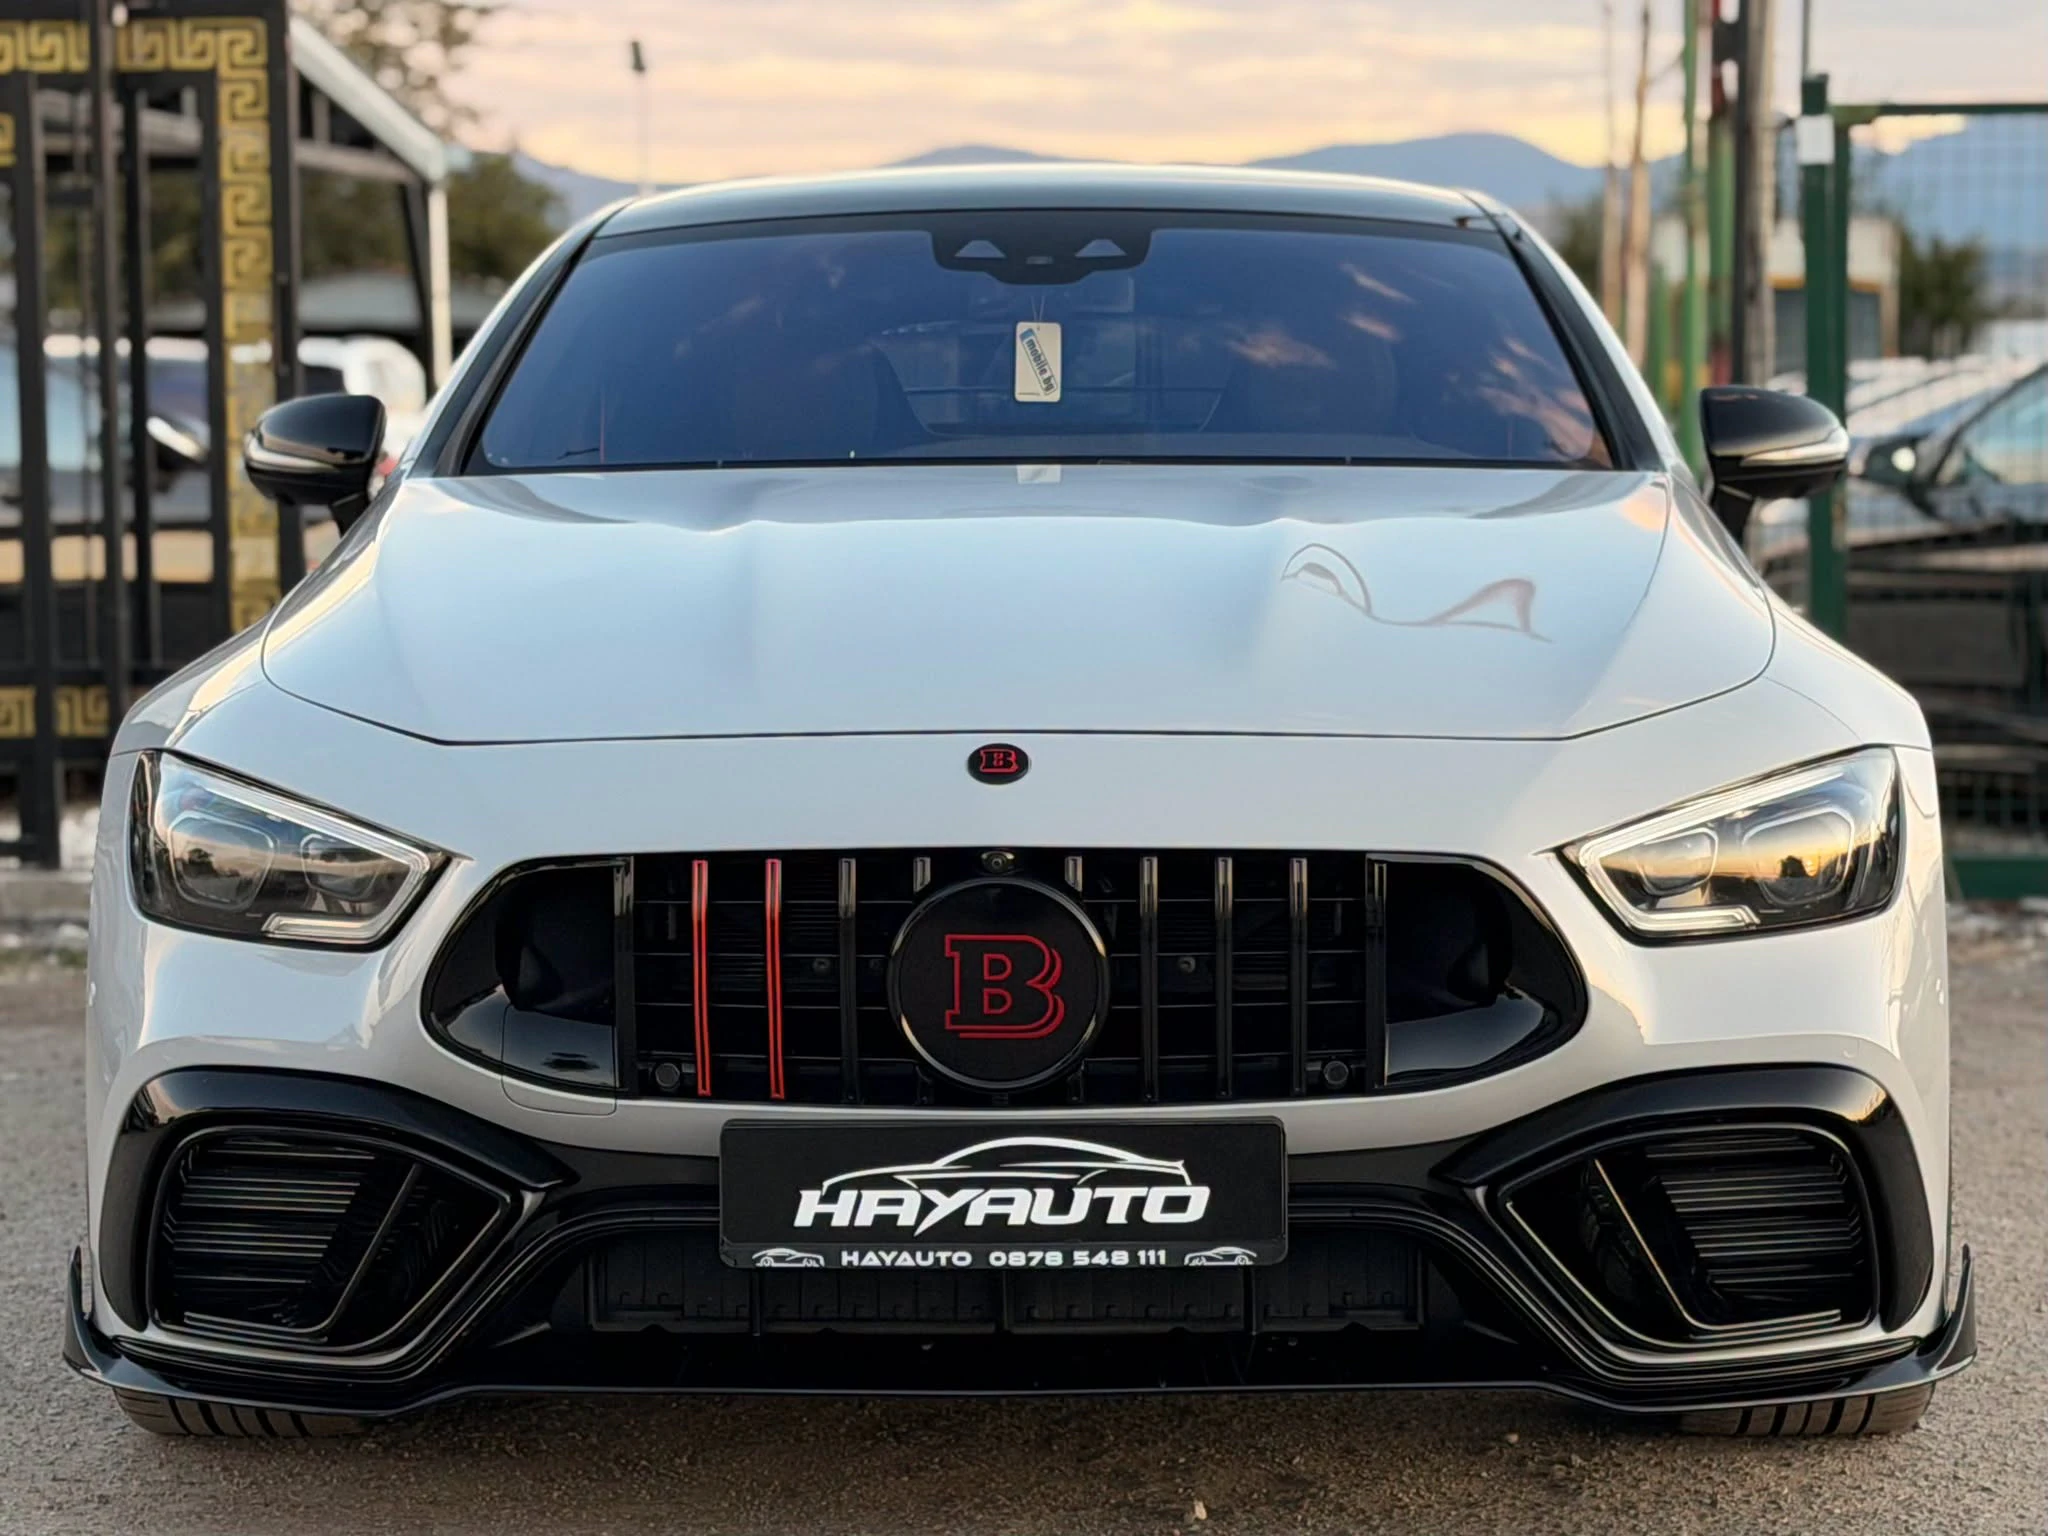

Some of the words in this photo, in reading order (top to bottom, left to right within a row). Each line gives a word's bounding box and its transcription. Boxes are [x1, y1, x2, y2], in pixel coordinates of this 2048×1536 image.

[979, 749, 1018, 772] B
[945, 934, 1065, 1038] B
[794, 1186, 1211, 1236] HAYAUTO
[841, 1251, 973, 1267] HAYAUTO
[989, 1251, 1063, 1267] 0878
[1072, 1250, 1130, 1266] 548
[1137, 1249, 1166, 1266] 111
